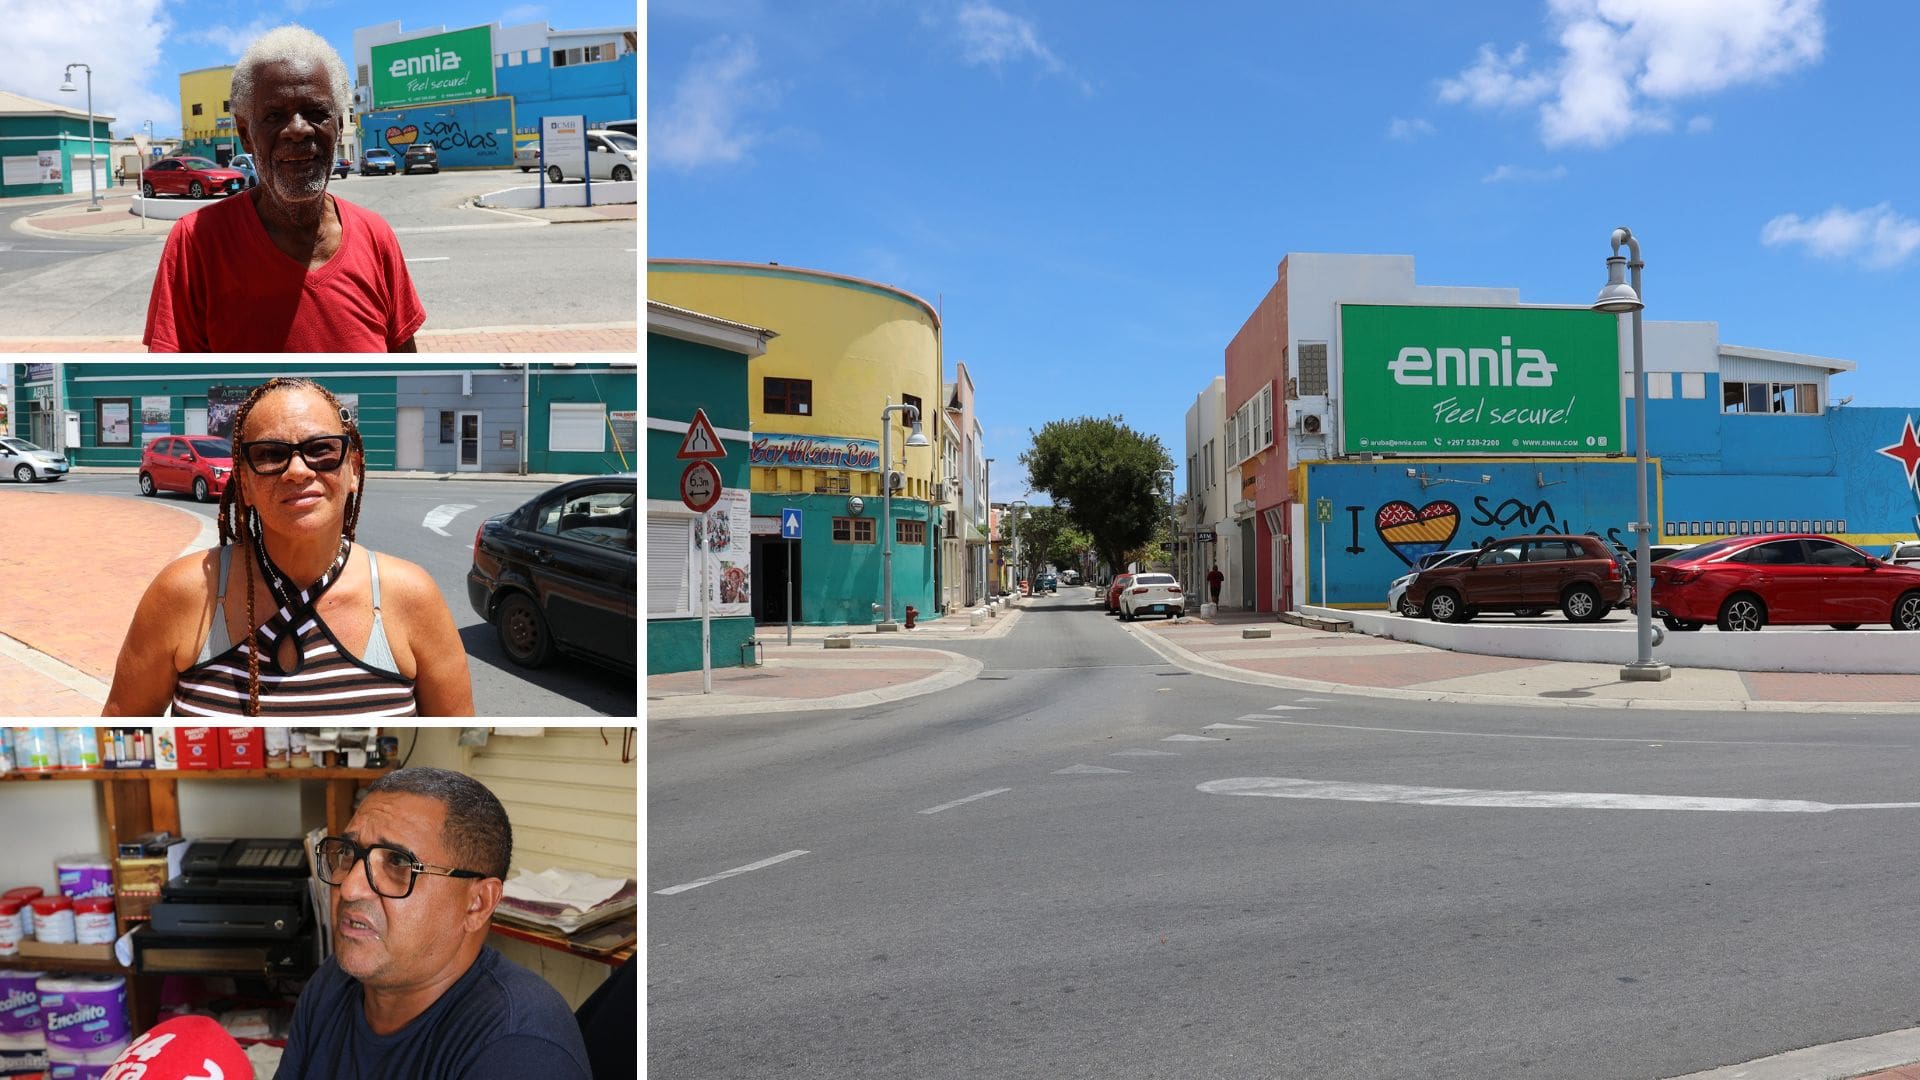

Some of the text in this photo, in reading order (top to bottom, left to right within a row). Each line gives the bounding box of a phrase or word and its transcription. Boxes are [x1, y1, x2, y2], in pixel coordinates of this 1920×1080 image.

[389, 47, 461, 77] ennia
[408, 70, 470, 91] Feel secure!
[424, 121, 460, 136] san
[1387, 335, 1558, 387] ennia
[33, 386, 49, 399] AEDA
[1433, 395, 1576, 424] Feel secure!
[751, 438, 878, 467] Caribbean Bar
[1370, 439, 1427, 447] aruba@ennia.com
[690, 472, 709, 488] 6,3m
[1470, 496, 1555, 531] san
[1345, 505, 1366, 555] I
[47, 1005, 106, 1031] Encanto
